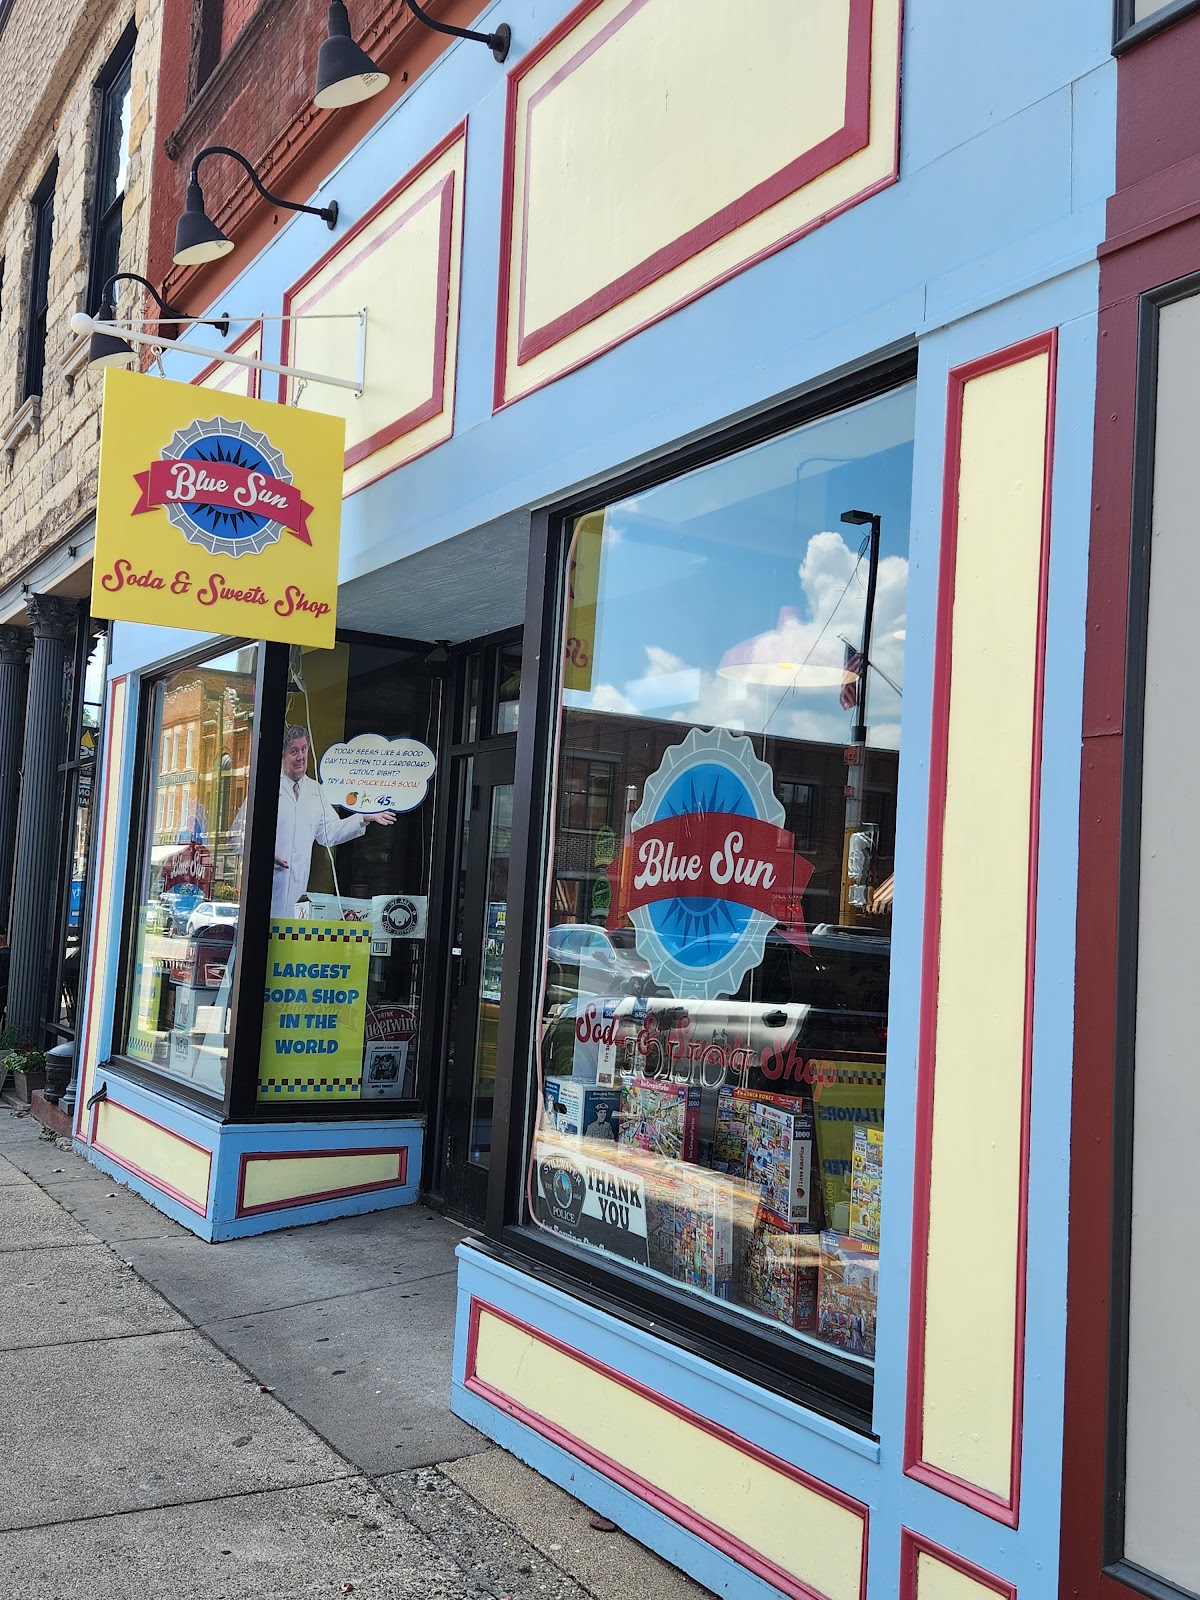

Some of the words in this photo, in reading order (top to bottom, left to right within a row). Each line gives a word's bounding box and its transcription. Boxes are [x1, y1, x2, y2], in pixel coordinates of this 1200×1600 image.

[165, 462, 229, 501] Blue
[233, 472, 289, 510] Sun
[101, 558, 166, 592] Soda
[170, 570, 193, 594] &
[196, 573, 269, 606] Sweets
[273, 585, 331, 619] Shop
[356, 748, 379, 756] SEEMS
[348, 758, 370, 766] LISTEN
[388, 760, 430, 768] CARDBOARD
[376, 769, 401, 777] RIGHT?
[377, 796, 392, 806] 45
[170, 853, 189, 879] Blue
[189, 850, 206, 879] Sun
[634, 838, 703, 890] Blue
[710, 831, 777, 889] Sun
[273, 962, 351, 979] LARGEST
[263, 988, 309, 1004] SODA
[312, 988, 359, 1005] SHOP
[279, 1014, 300, 1029] IN
[304, 1014, 338, 1029] THE
[376, 1011, 394, 1019] DRINK
[275, 1039, 339, 1055] WORLD
[575, 1002, 628, 1047] Soda
[637, 1014, 660, 1056] &
[666, 1015, 754, 1070] Sweets
[760, 1033, 837, 1103] Shop
[543, 1159, 582, 1186] STILLWATER
[586, 1165, 642, 1209] THANK
[552, 1206, 576, 1224] POLICE
[598, 1196, 630, 1231] YOU
